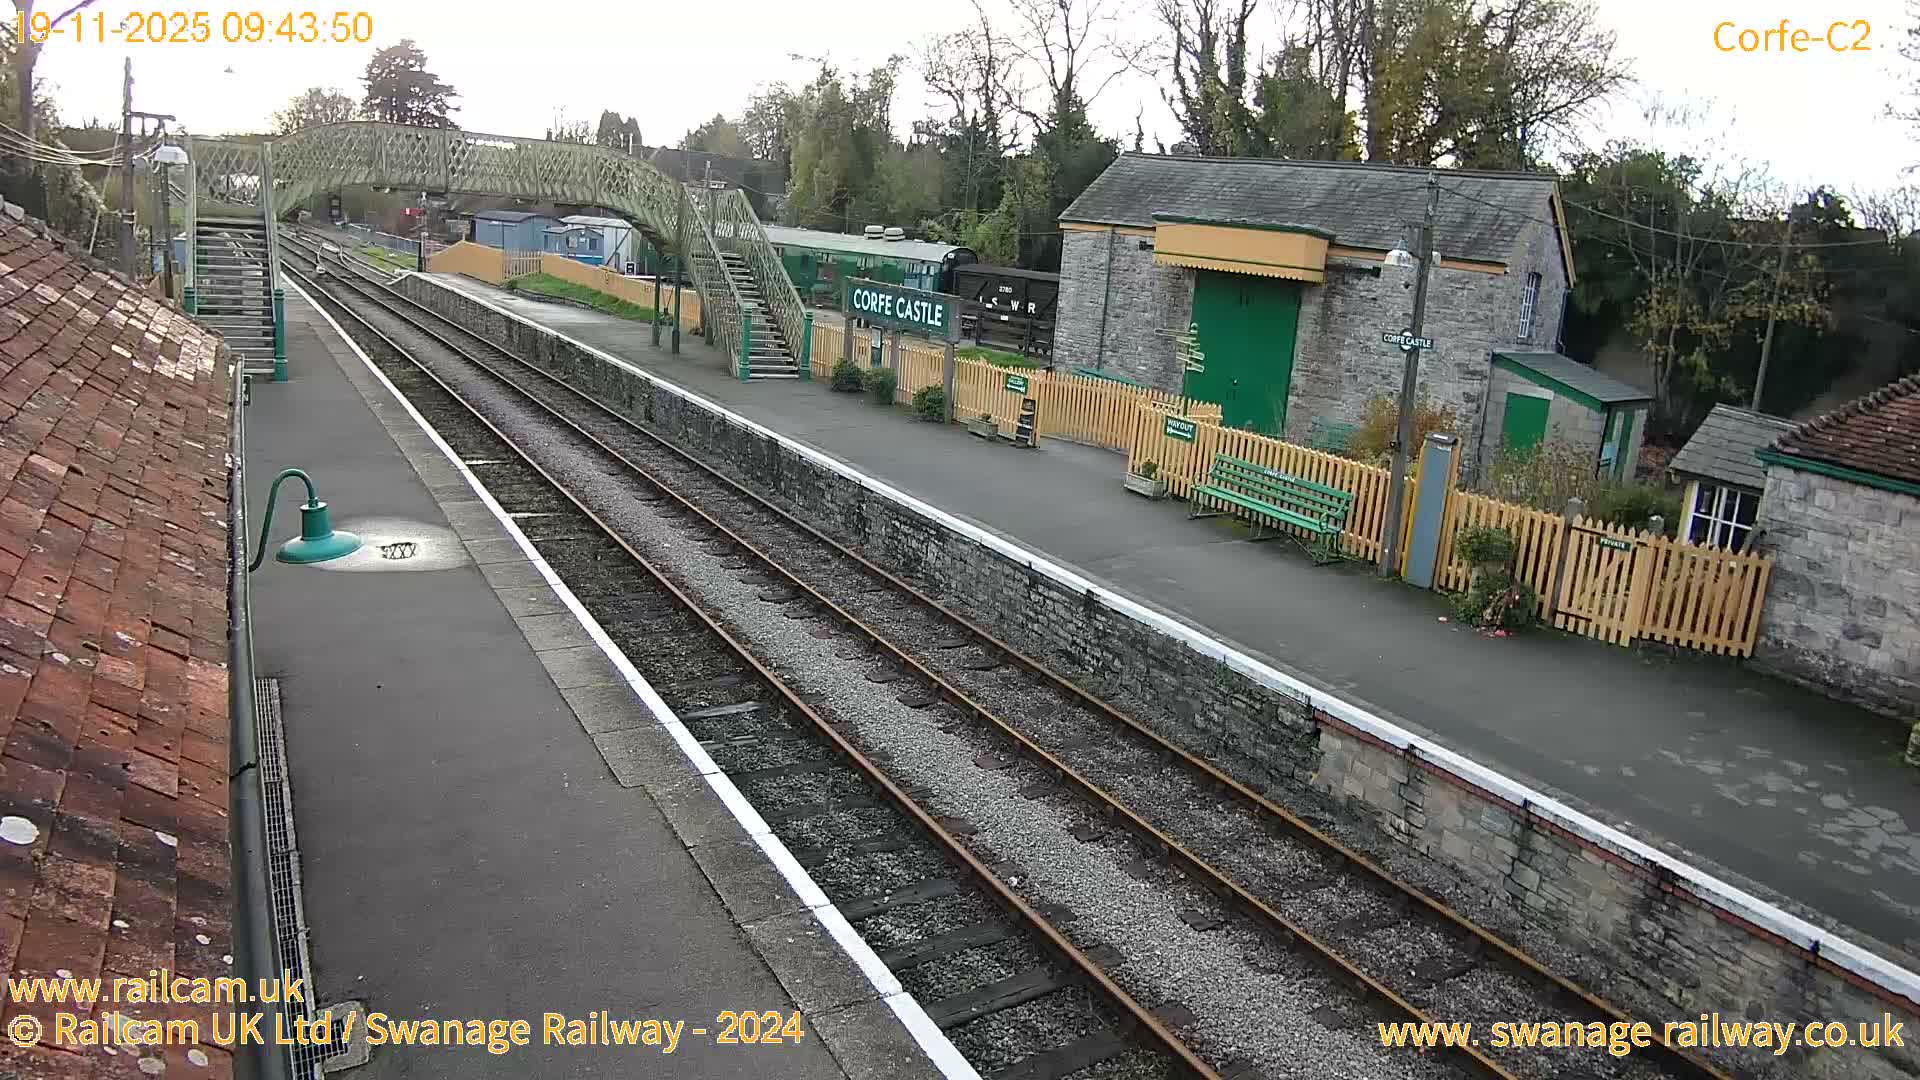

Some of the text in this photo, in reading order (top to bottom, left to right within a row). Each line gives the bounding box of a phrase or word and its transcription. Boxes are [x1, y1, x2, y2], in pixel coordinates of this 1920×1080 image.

[854, 288, 943, 327] CORFE CASTLE
[1383, 333, 1432, 349] CORFE CASTLE
